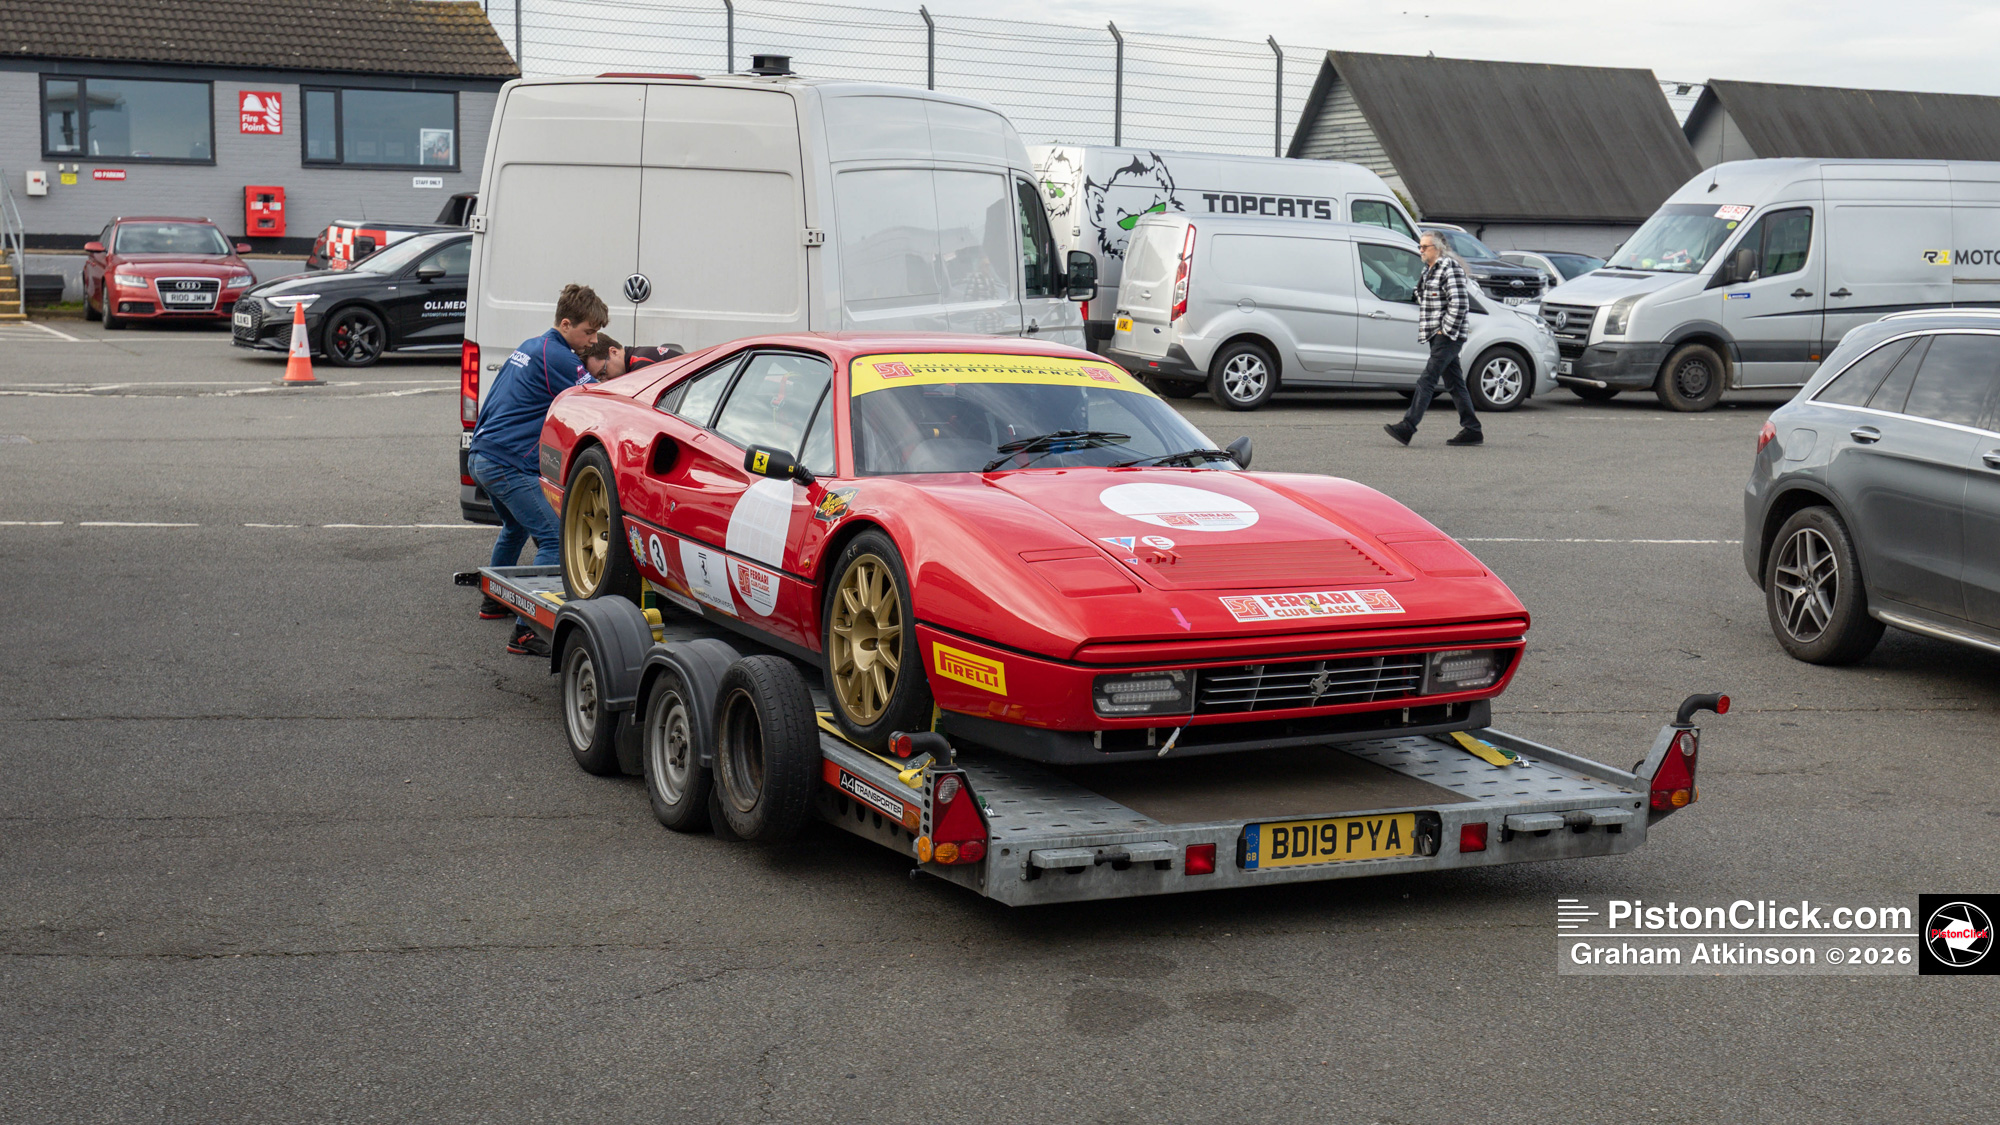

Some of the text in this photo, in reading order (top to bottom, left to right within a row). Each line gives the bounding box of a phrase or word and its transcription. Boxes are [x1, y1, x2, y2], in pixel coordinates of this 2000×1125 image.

[242, 114, 258, 122] Fire
[242, 123, 265, 132] Point
[1203, 193, 1331, 220] TOPCATS
[424, 301, 466, 310] OLI.MED
[912, 368, 1087, 378] SUPERFORMANCE
[652, 539, 664, 573] 3
[750, 569, 769, 585] FERRARI
[490, 580, 502, 596] BRIAN
[502, 587, 516, 604] JAMES
[515, 594, 536, 614] TRAILERS
[1260, 592, 1356, 608] FERRARI
[1273, 609, 1310, 617] CLUB
[939, 650, 999, 688] PIRELLI
[841, 773, 902, 815] A4 TRANSPORTER
[1271, 819, 1402, 859] BD19 PYA
[1246, 852, 1257, 861] GB
